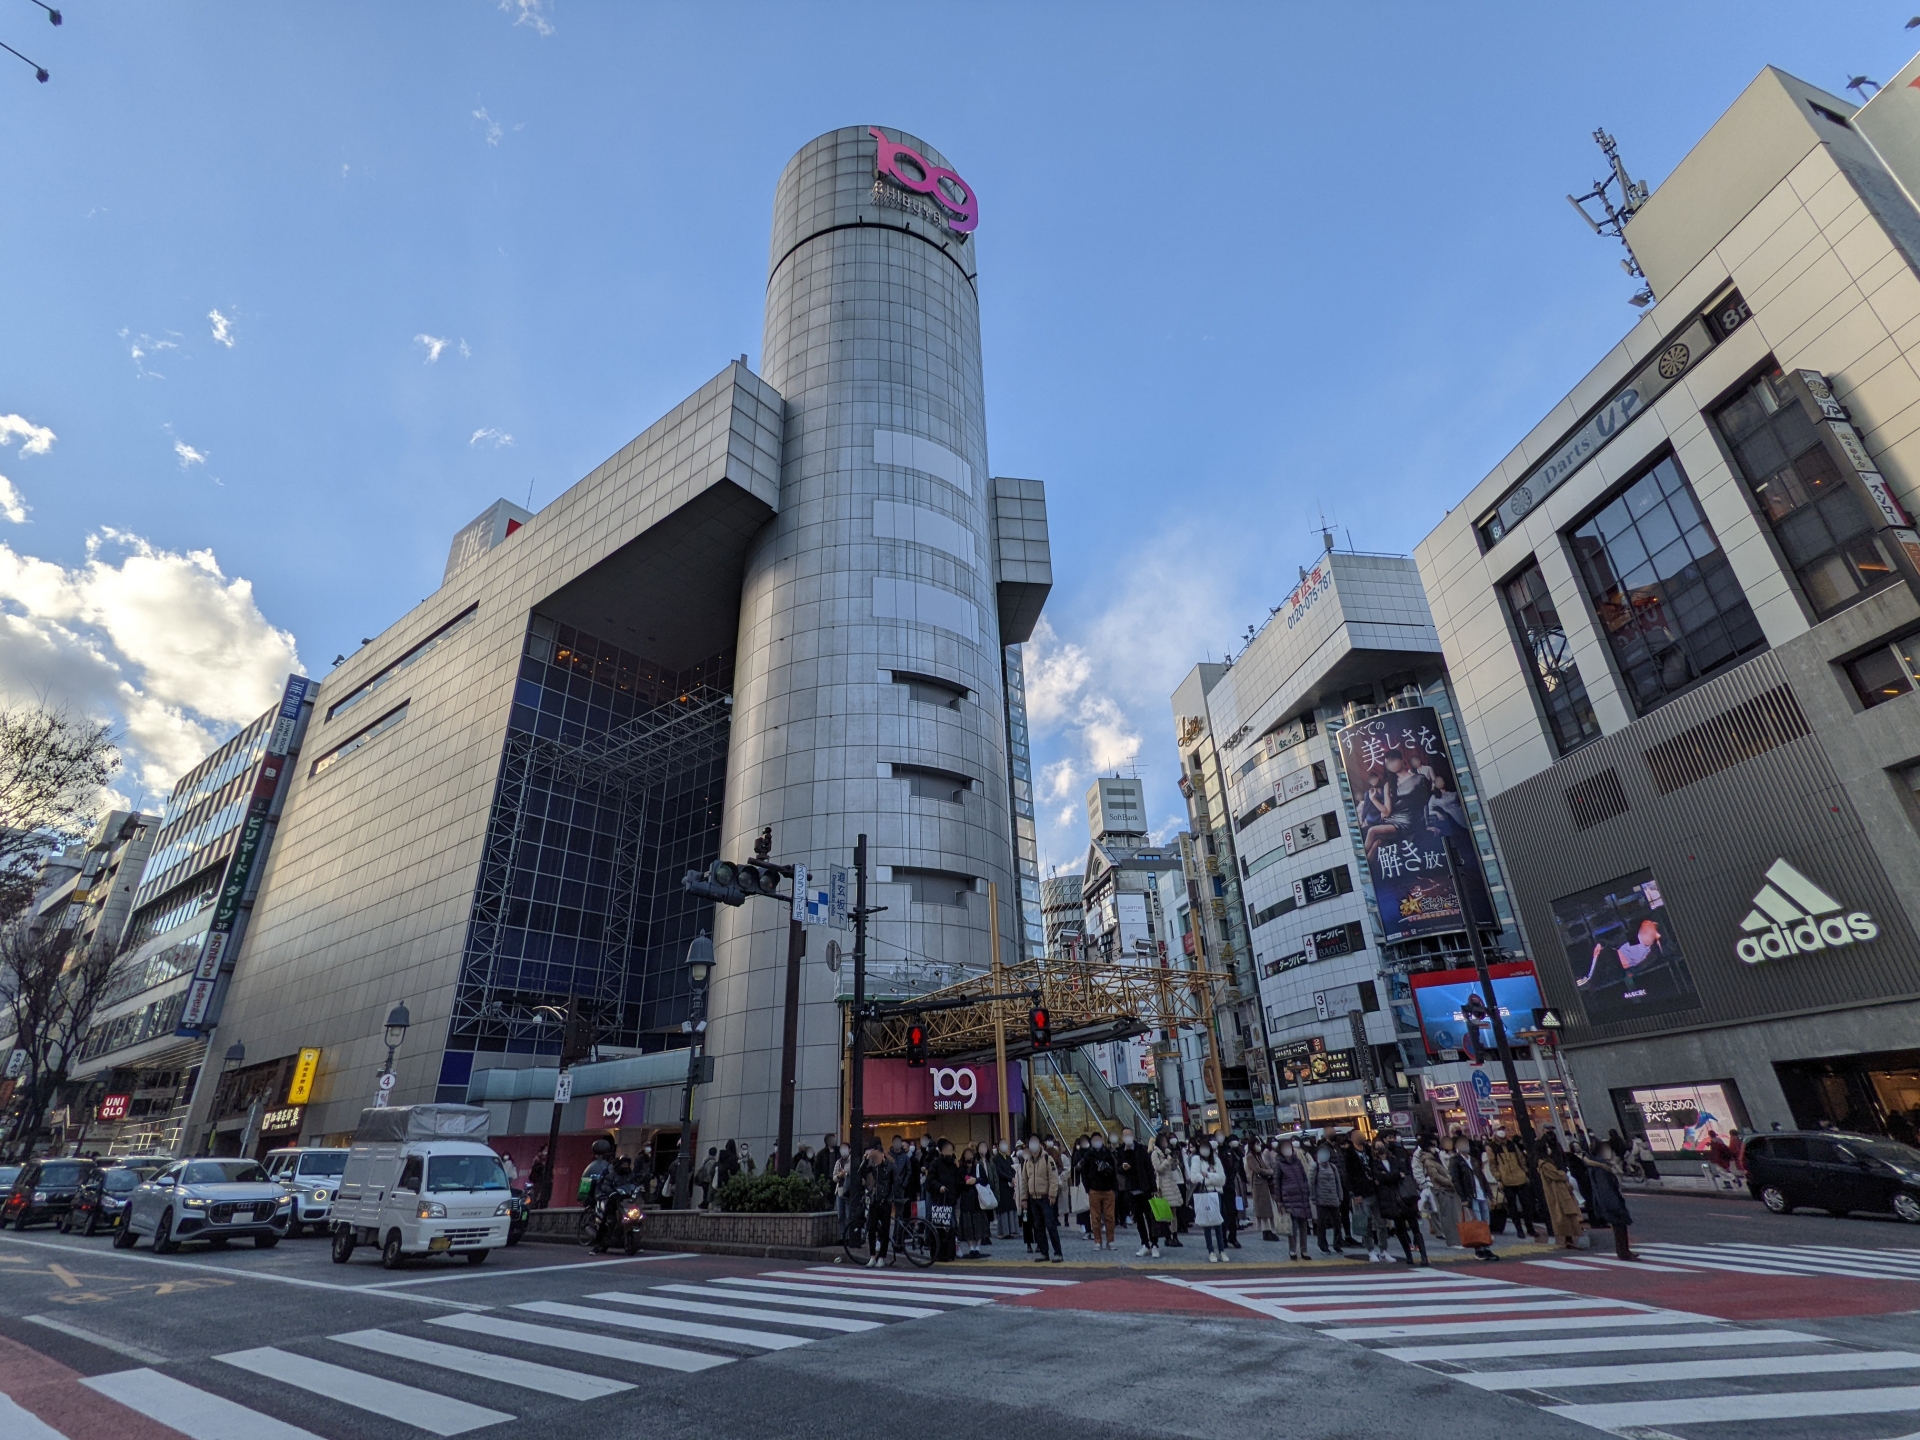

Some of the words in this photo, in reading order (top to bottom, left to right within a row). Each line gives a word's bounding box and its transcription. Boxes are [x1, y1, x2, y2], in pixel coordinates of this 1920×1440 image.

[868, 125, 979, 233] 109
[872, 181, 941, 226] SHIBUYA
[1722, 301, 1749, 330] 8F
[1543, 438, 1591, 484] Darts
[1596, 388, 1639, 437] UP
[1870, 484, 1898, 524] スシロー
[288, 681, 304, 697] THE
[282, 694, 302, 718] PRIME
[1342, 721, 1385, 756] すべての
[1361, 726, 1446, 772] 美しさを、
[837, 871, 846, 925] 道玄坂下
[216, 922, 228, 931] 3F
[808, 914, 827, 925] 時差式
[1315, 928, 1345, 943] ダーツバー
[1737, 912, 1878, 963] adidas
[1279, 953, 1307, 972] ダーツバー
[382, 1075, 391, 1087] 4
[930, 1067, 977, 1110] 109
[102, 1107, 123, 1117] QLO
[105, 1097, 125, 1107] UNI
[603, 1096, 623, 1124] 109
[934, 1100, 962, 1110] SHIBUYA
